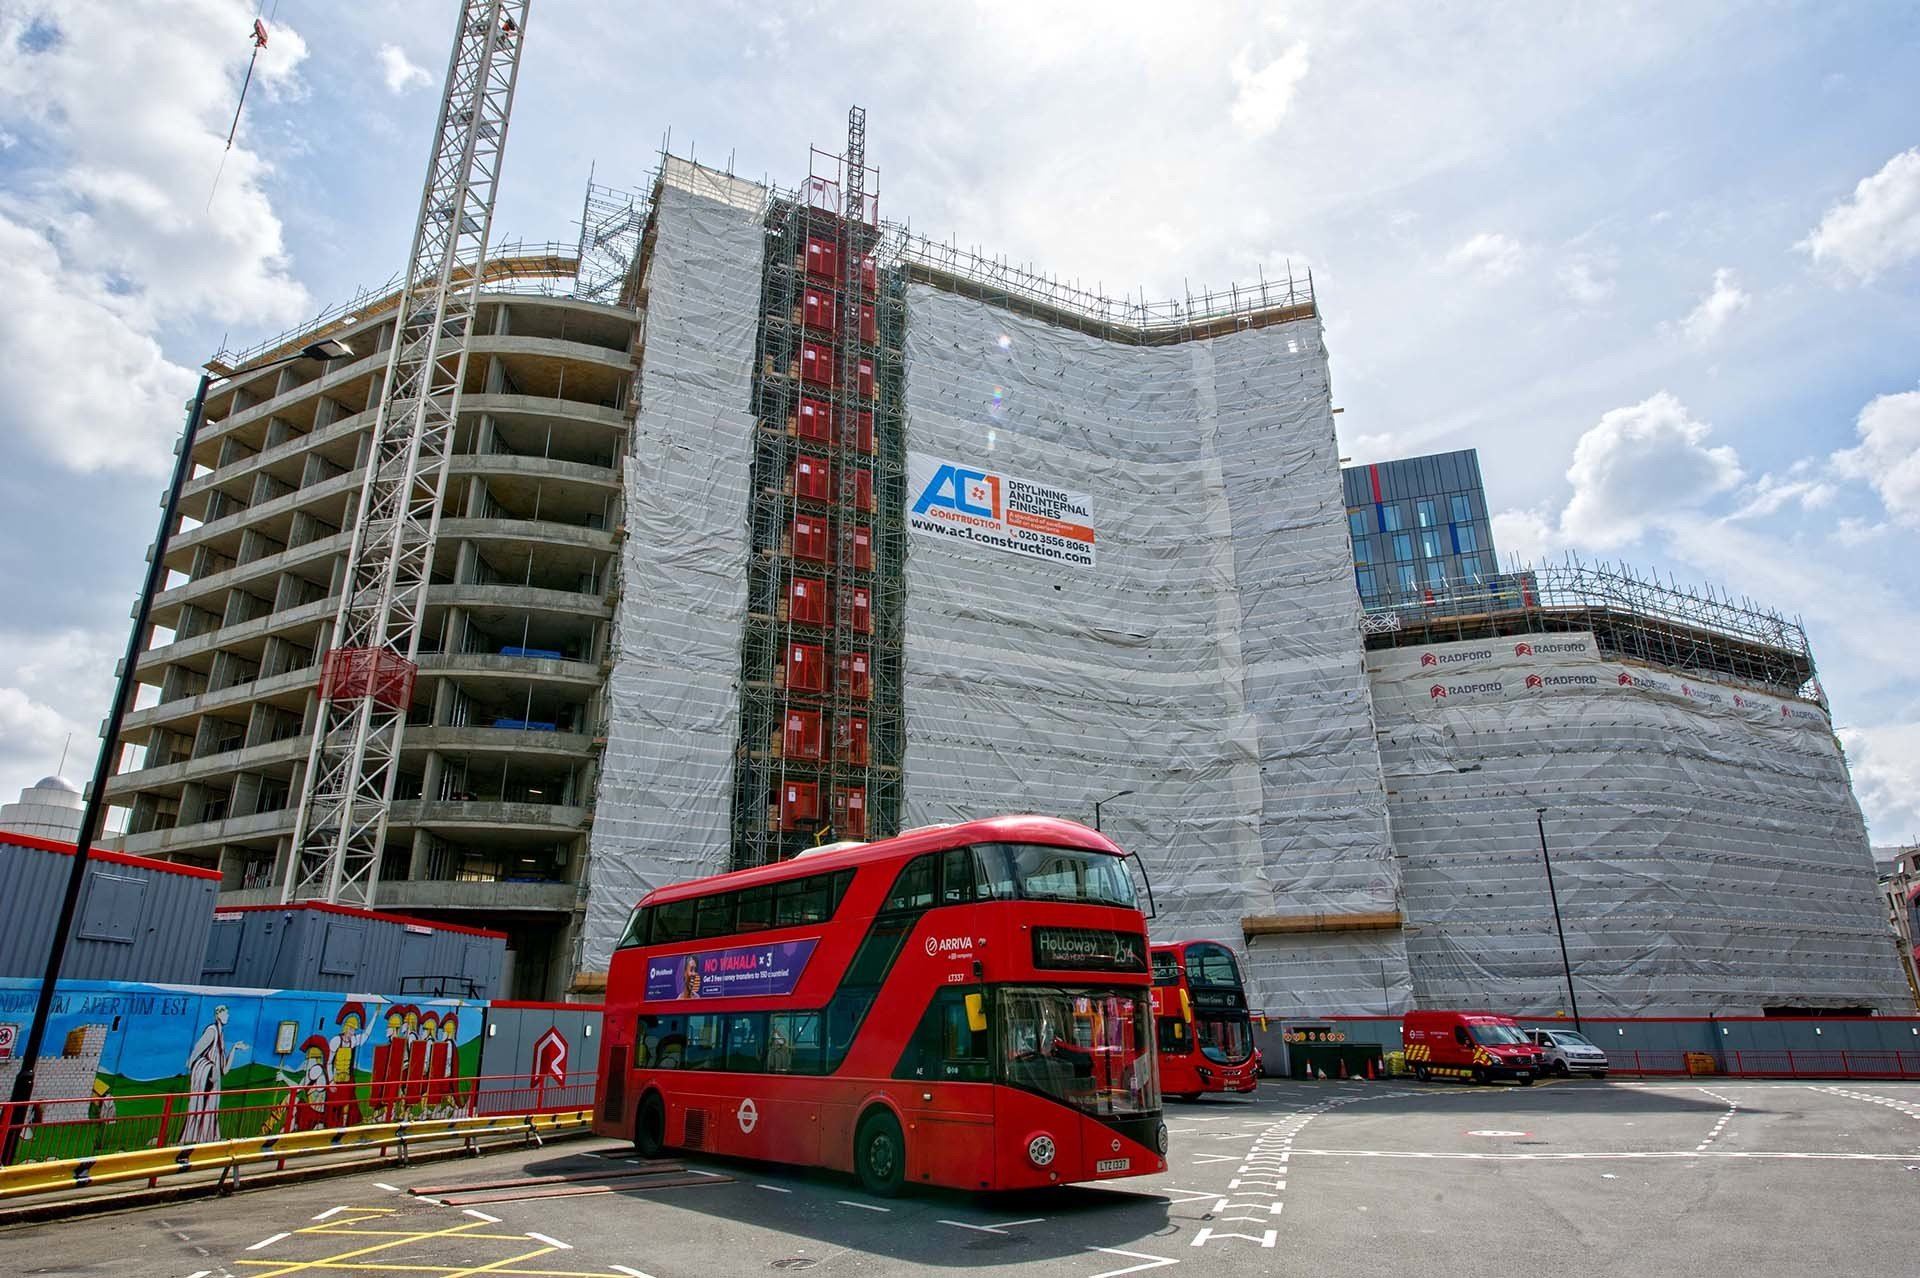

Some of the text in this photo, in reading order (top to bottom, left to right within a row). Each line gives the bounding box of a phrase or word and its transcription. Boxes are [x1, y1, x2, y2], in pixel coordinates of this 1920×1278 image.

[912, 464, 1000, 519] AC1
[1008, 480, 1068, 502] DRYLINING
[1009, 490, 1089, 517] AND INTERNAL
[1009, 500, 1061, 519] FINISHES
[930, 508, 1000, 530] CONSTRUCTION
[912, 519, 1092, 565] www.ac1construction.com
[1019, 530, 1091, 553] 020 3556 8061
[1439, 650, 1492, 663] RADFORD
[1534, 643, 1586, 654] RADFORD
[1448, 682, 1502, 695] RADFORD
[1544, 675, 1597, 685] RADFORD
[939, 937, 973, 951] ARRIVA
[1040, 932, 1134, 963] Holloway 254
[704, 959, 718, 972] NO
[720, 954, 757, 971] WAHALA
[766, 952, 772, 967] 3
[703, 975, 711, 983] Get
[736, 972, 754, 980] transfers
[948, 973, 964, 982] LT337
[79, 997, 154, 1016] APERTUM
[161, 998, 190, 1017] EST
[1226, 994, 1236, 1006] 67
